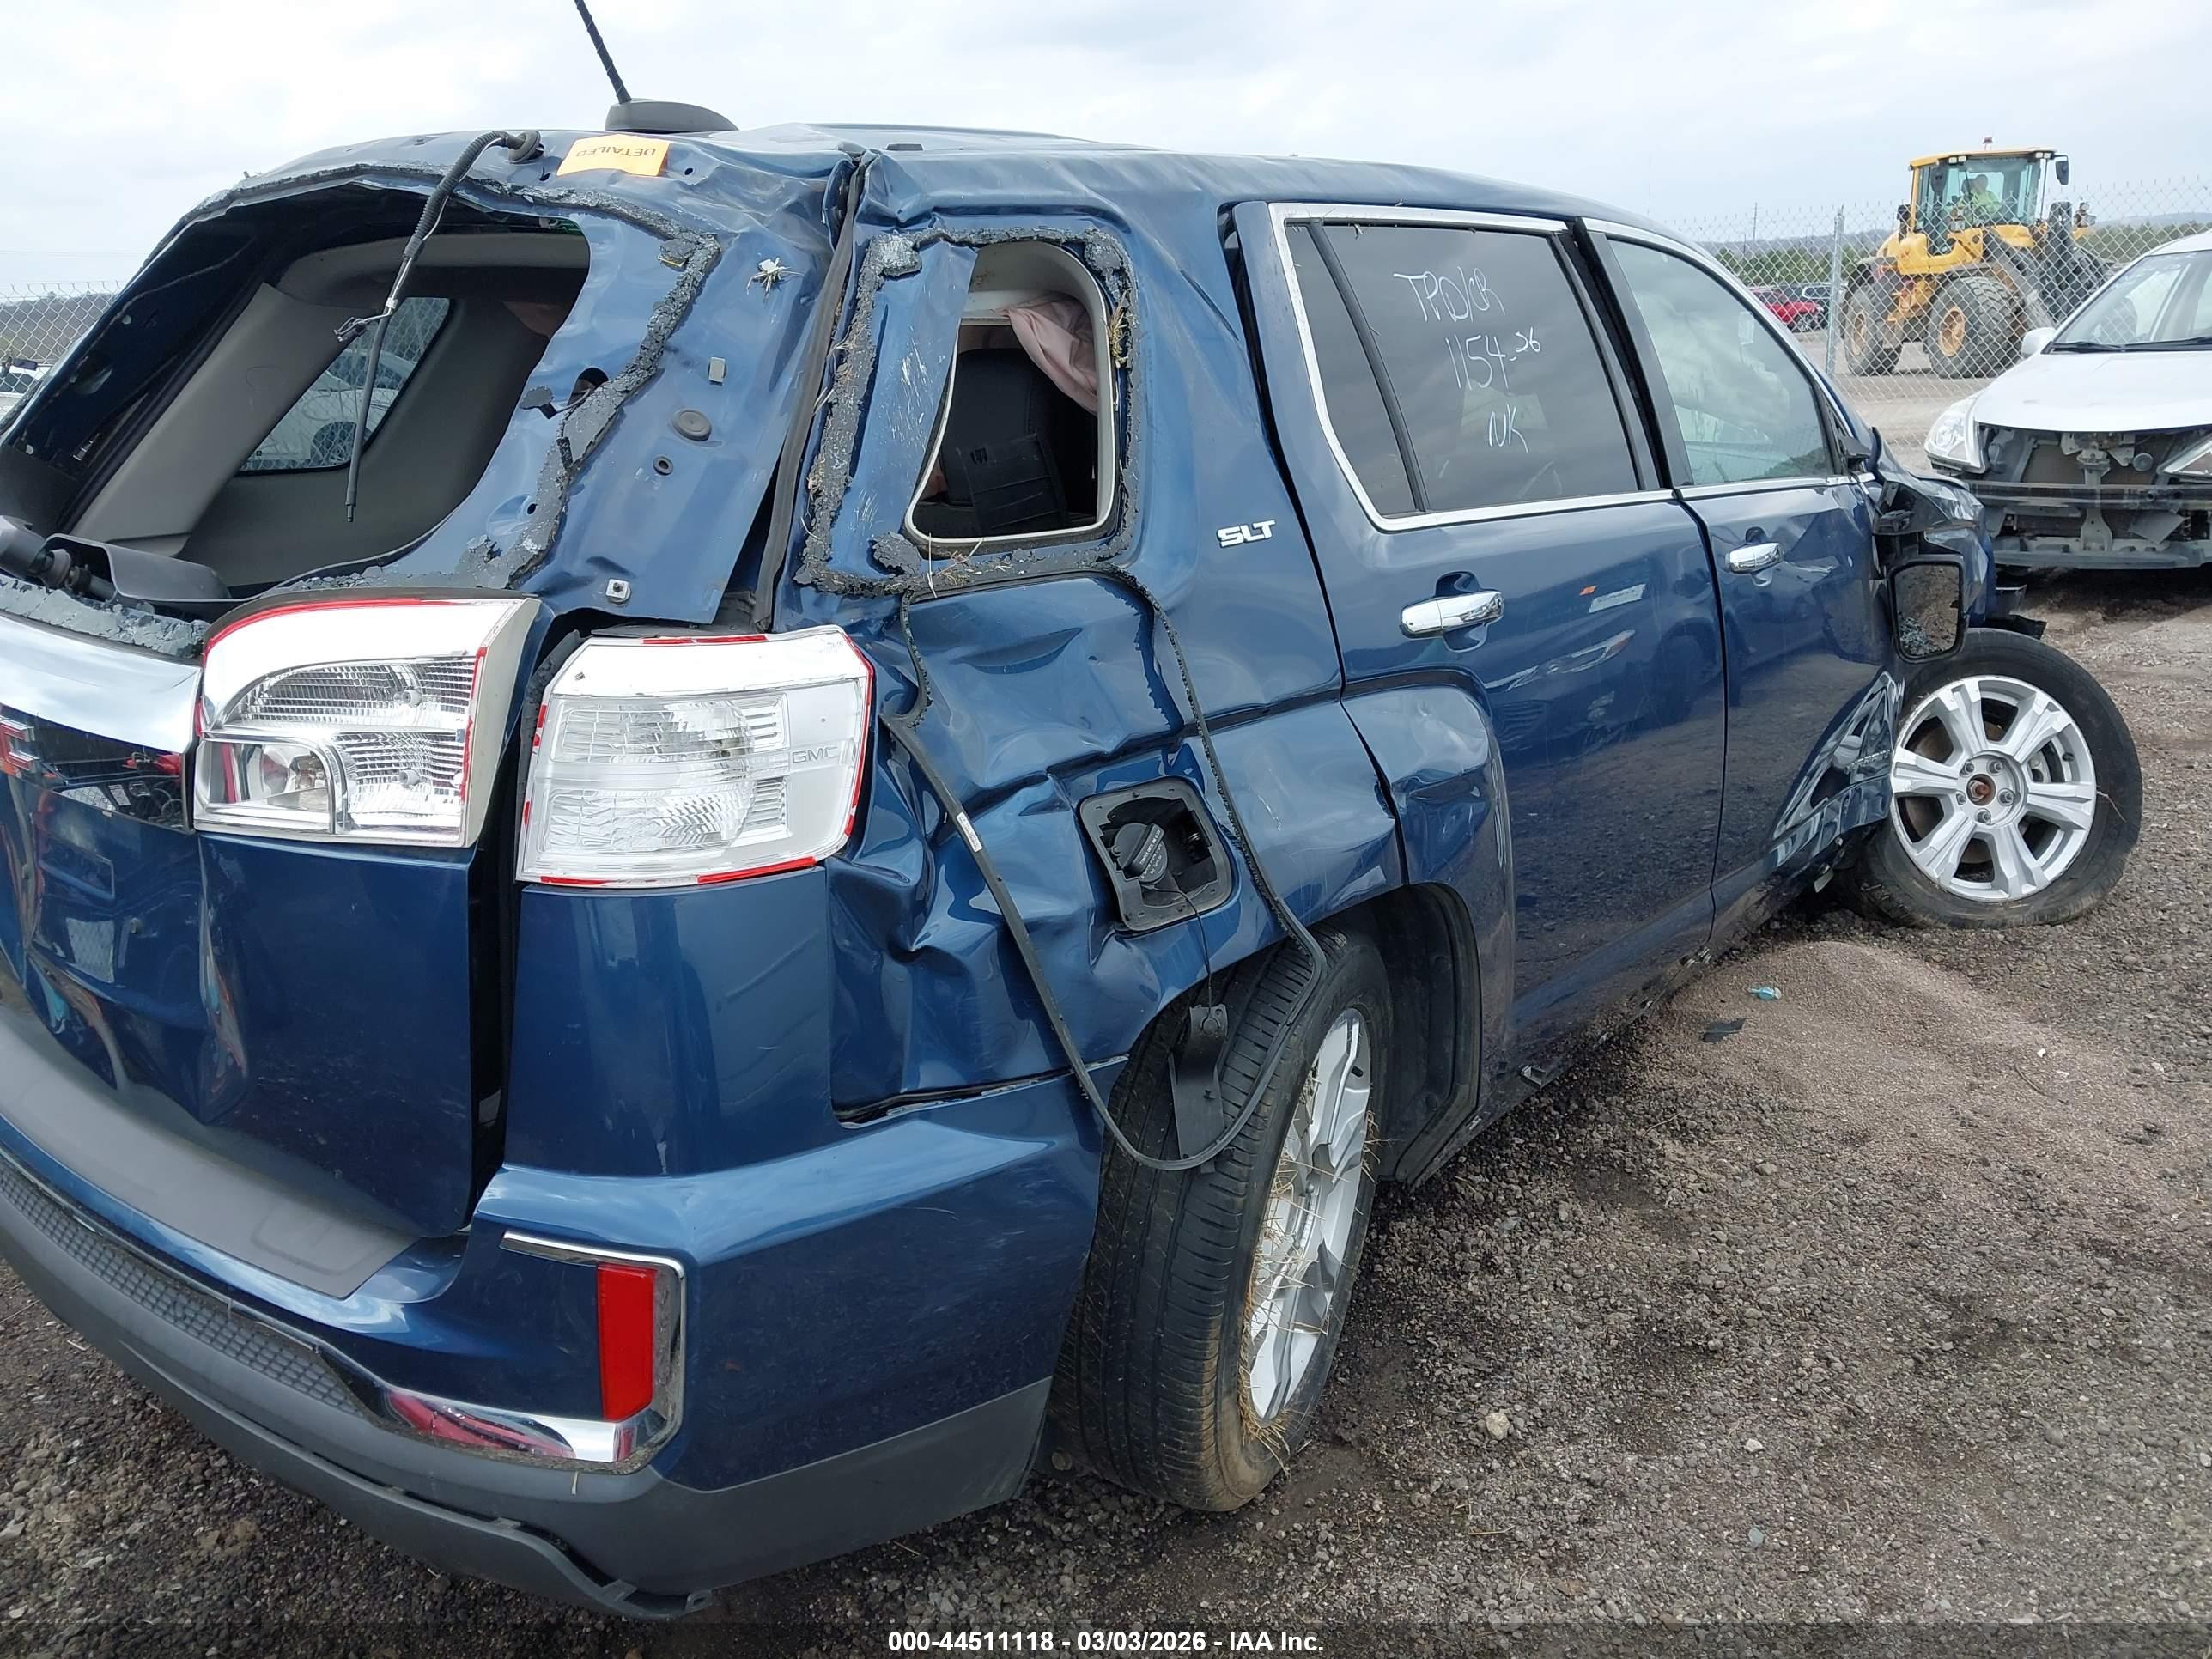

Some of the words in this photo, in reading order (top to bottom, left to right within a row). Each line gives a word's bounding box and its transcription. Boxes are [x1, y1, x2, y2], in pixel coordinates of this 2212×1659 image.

[576, 146, 656, 157] DETAILED
[1217, 519, 1277, 548] SLT
[792, 746, 839, 763] GMC
